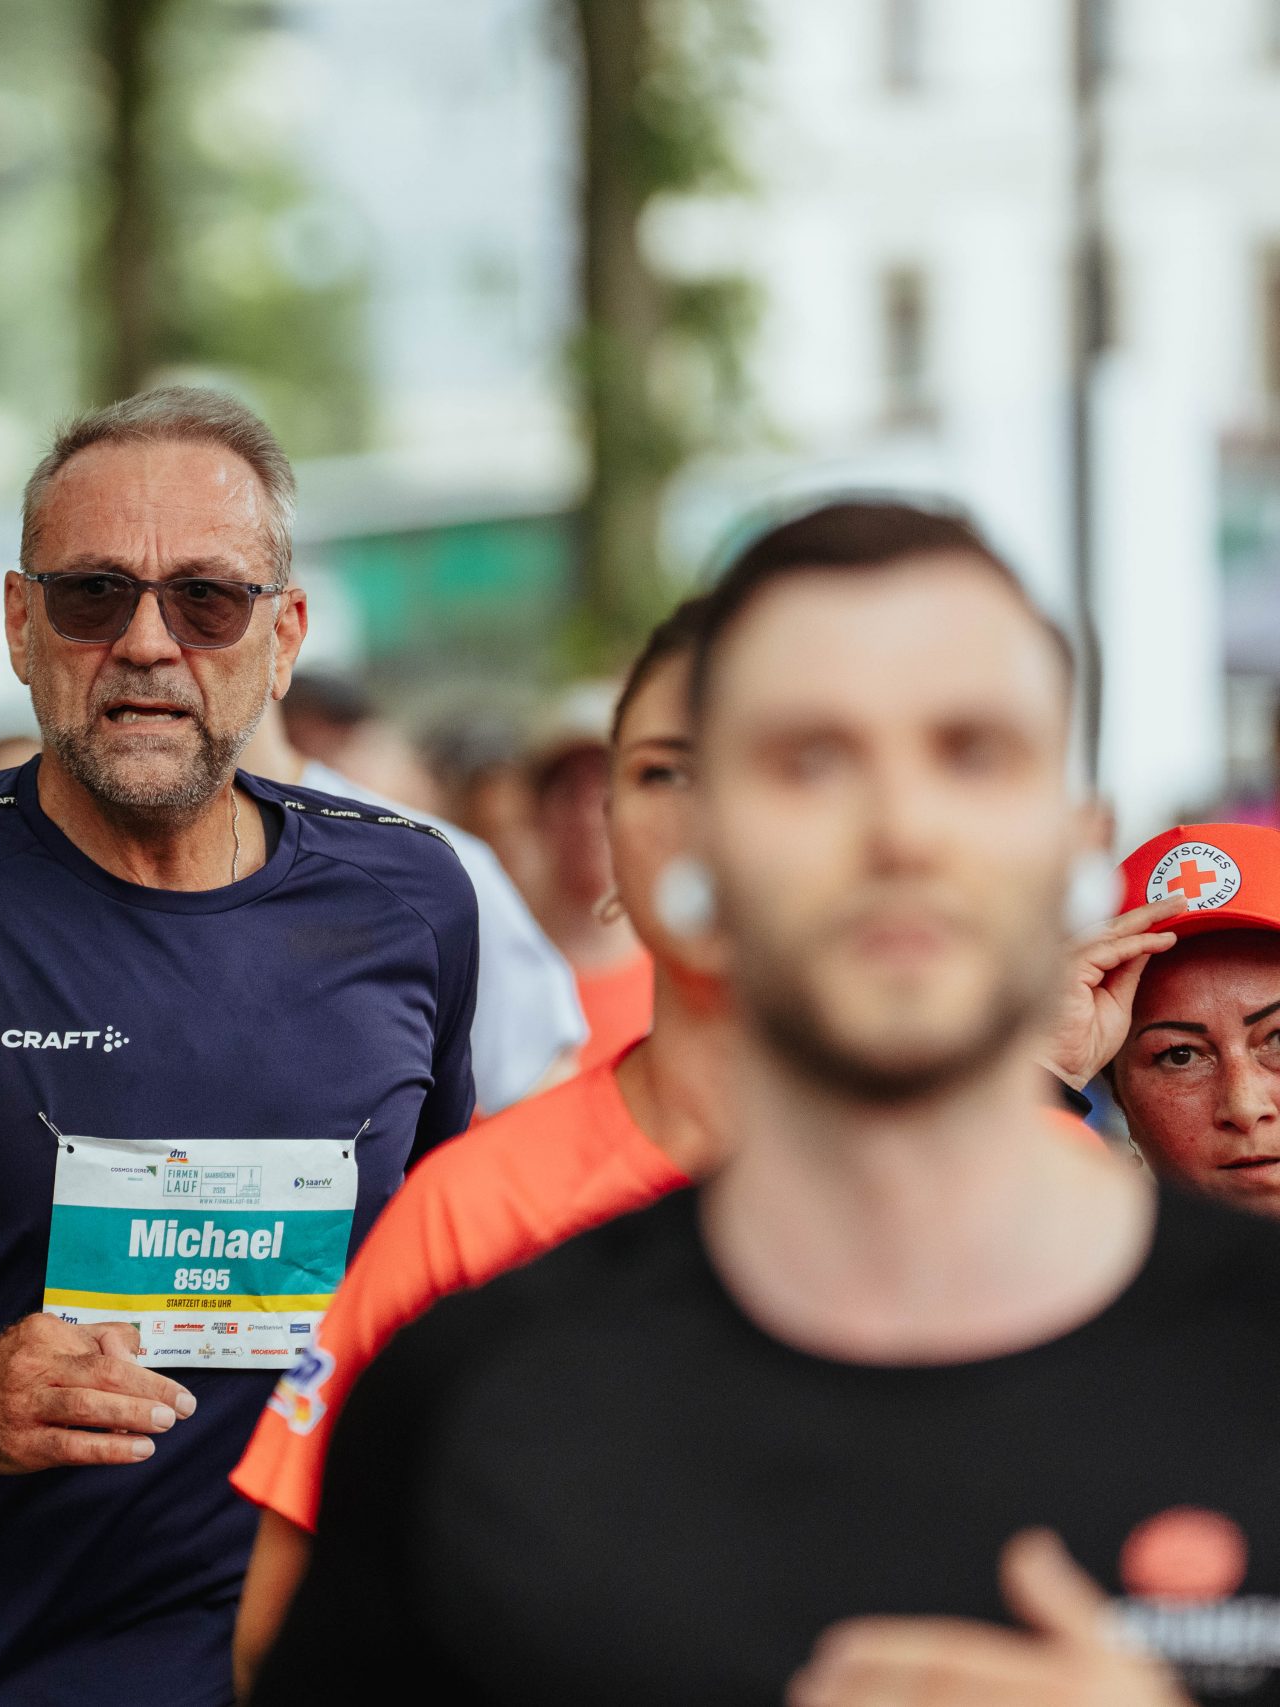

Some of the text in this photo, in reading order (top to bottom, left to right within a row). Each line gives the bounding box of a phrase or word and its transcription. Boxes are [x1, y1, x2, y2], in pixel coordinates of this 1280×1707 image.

[377, 816, 408, 825] CRAFT
[1152, 846, 1231, 885] DEUTSCHES
[1197, 877, 1236, 911] KREUZ
[1, 1029, 100, 1050] CRAFT
[170, 1149, 187, 1158] dm
[167, 1169, 199, 1179] FIRMEN
[166, 1180, 198, 1193] LAUF
[128, 1219, 285, 1260] Michael
[173, 1268, 231, 1291] 8595
[166, 1298, 232, 1308] STARTZEIT 18:15 UHR
